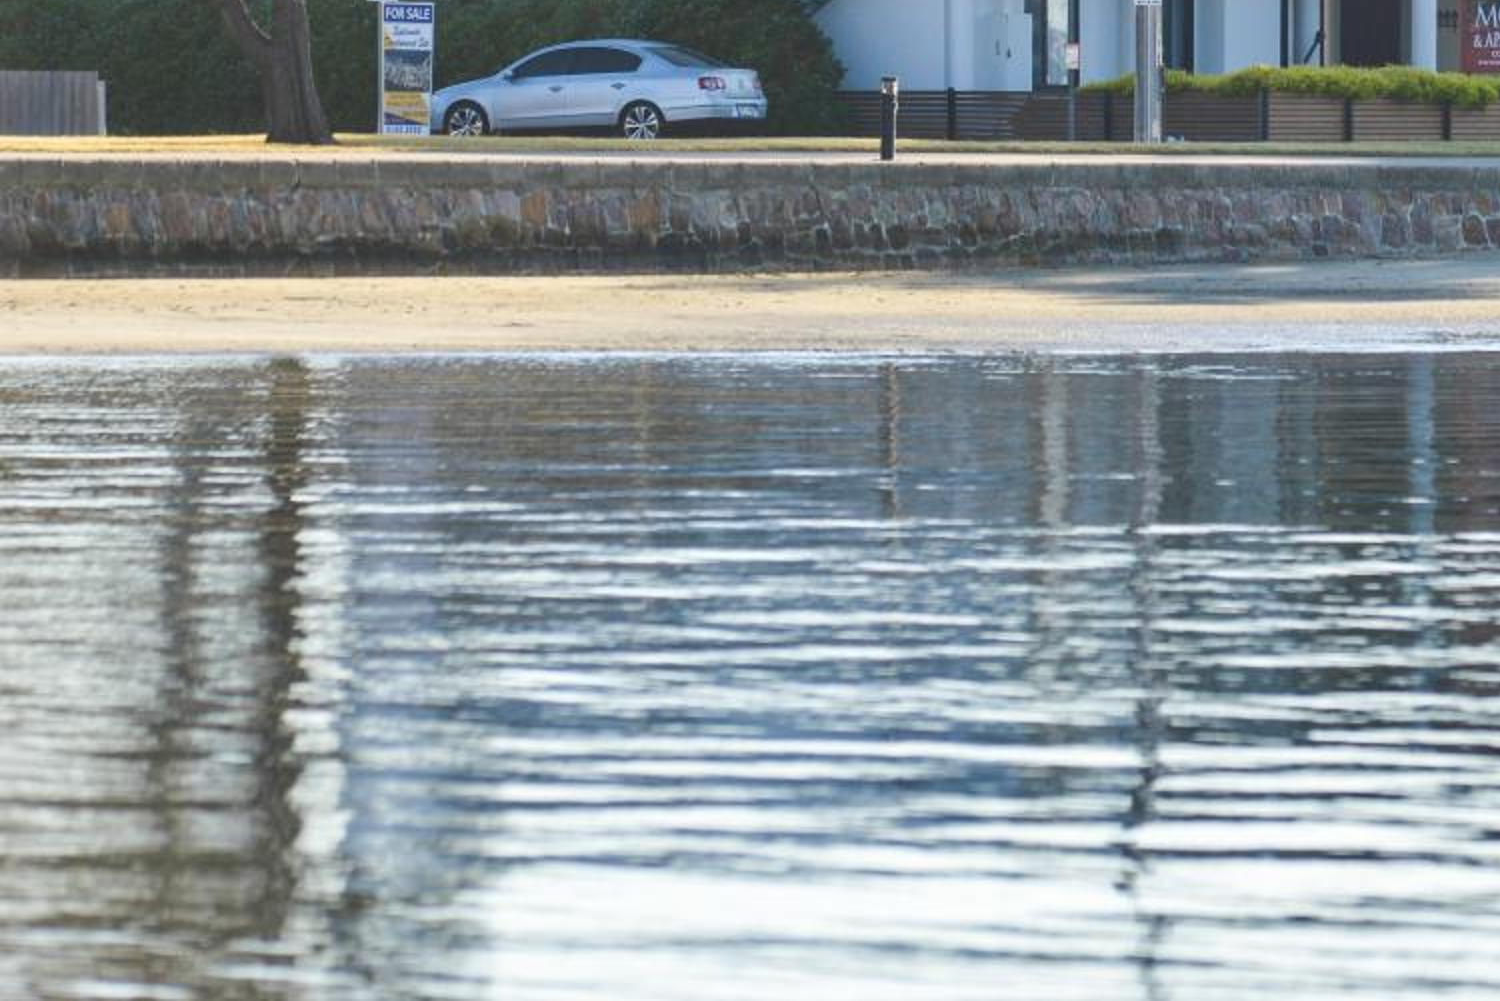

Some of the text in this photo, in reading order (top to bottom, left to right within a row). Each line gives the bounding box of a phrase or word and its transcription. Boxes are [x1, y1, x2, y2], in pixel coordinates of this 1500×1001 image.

[385, 7, 431, 20] FOR SALE
[1473, 33, 1483, 48] &
